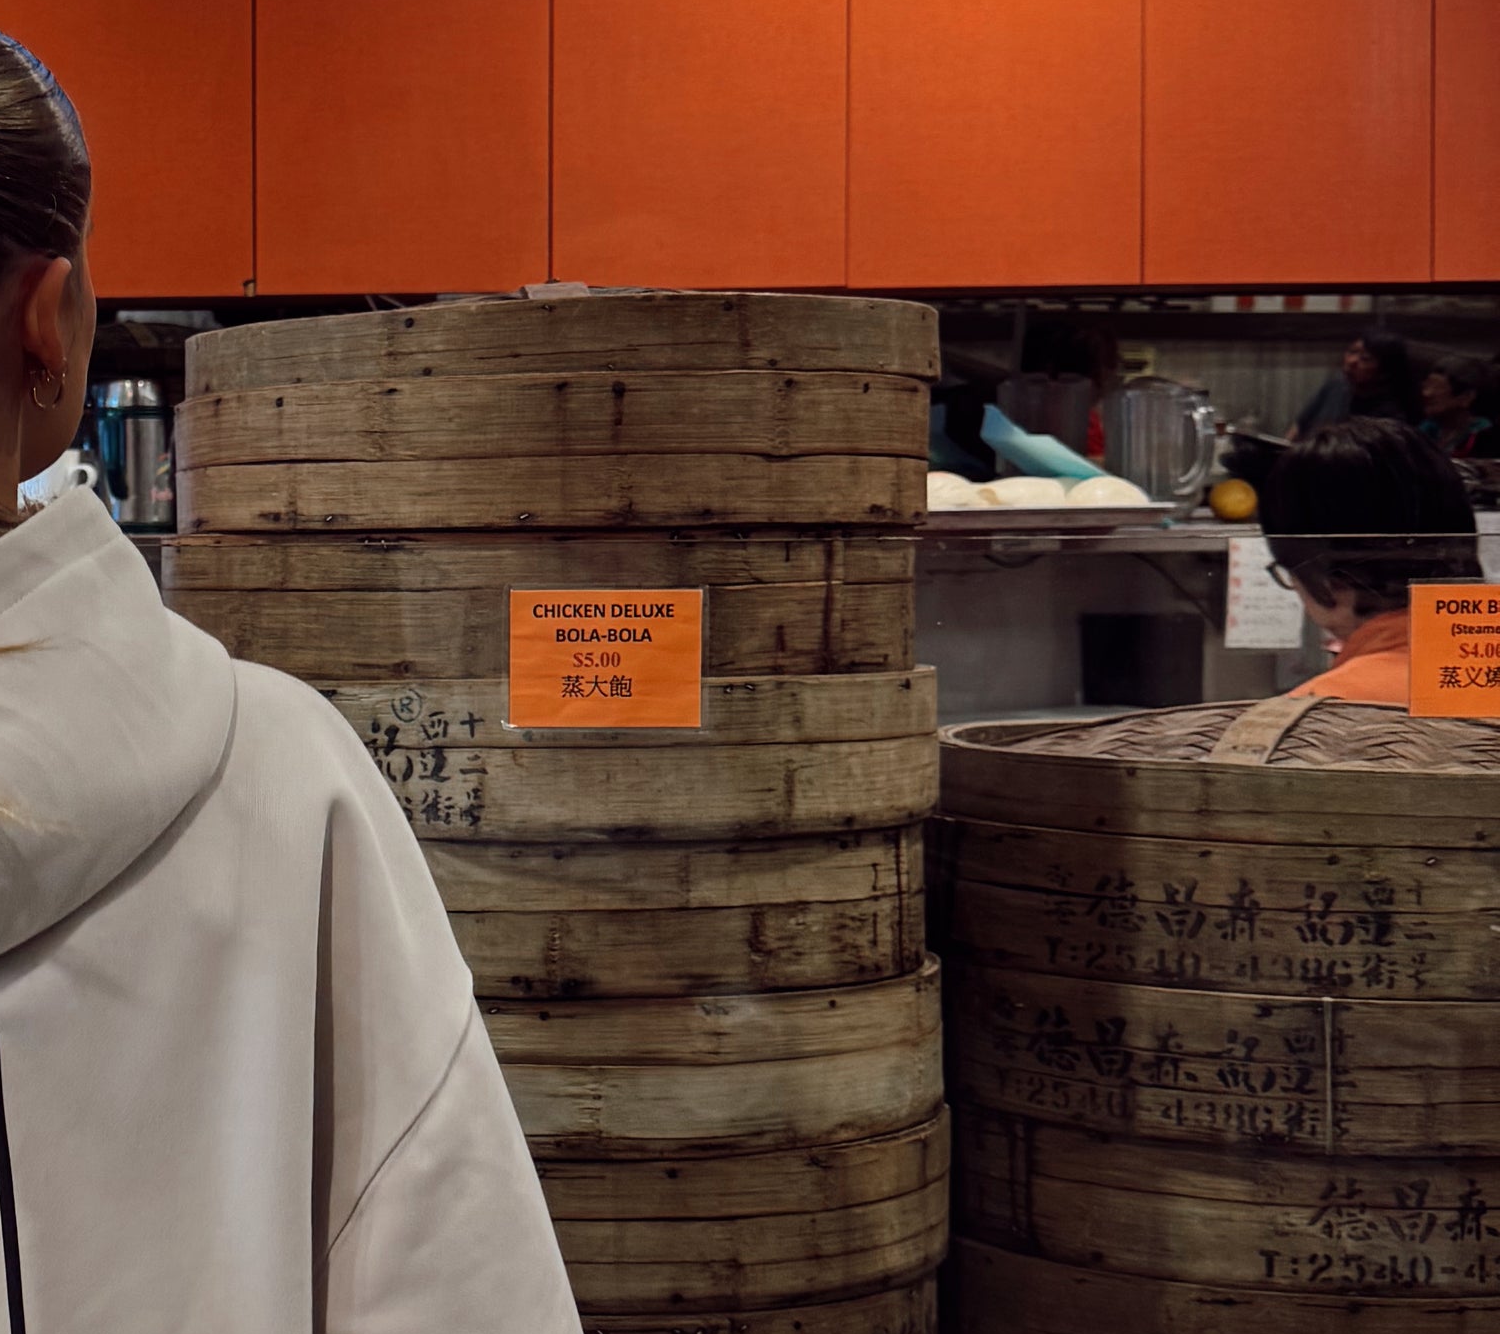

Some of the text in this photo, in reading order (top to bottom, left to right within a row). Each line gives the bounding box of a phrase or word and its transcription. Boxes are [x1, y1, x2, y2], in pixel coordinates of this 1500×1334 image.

[532, 603, 675, 619] CHICKEN DELUXE
[1435, 599, 1500, 615] PORK B
[555, 627, 653, 644] BOLA-BOLA
[572, 651, 621, 669] $5.00
[560, 674, 633, 700] 蒸大飽
